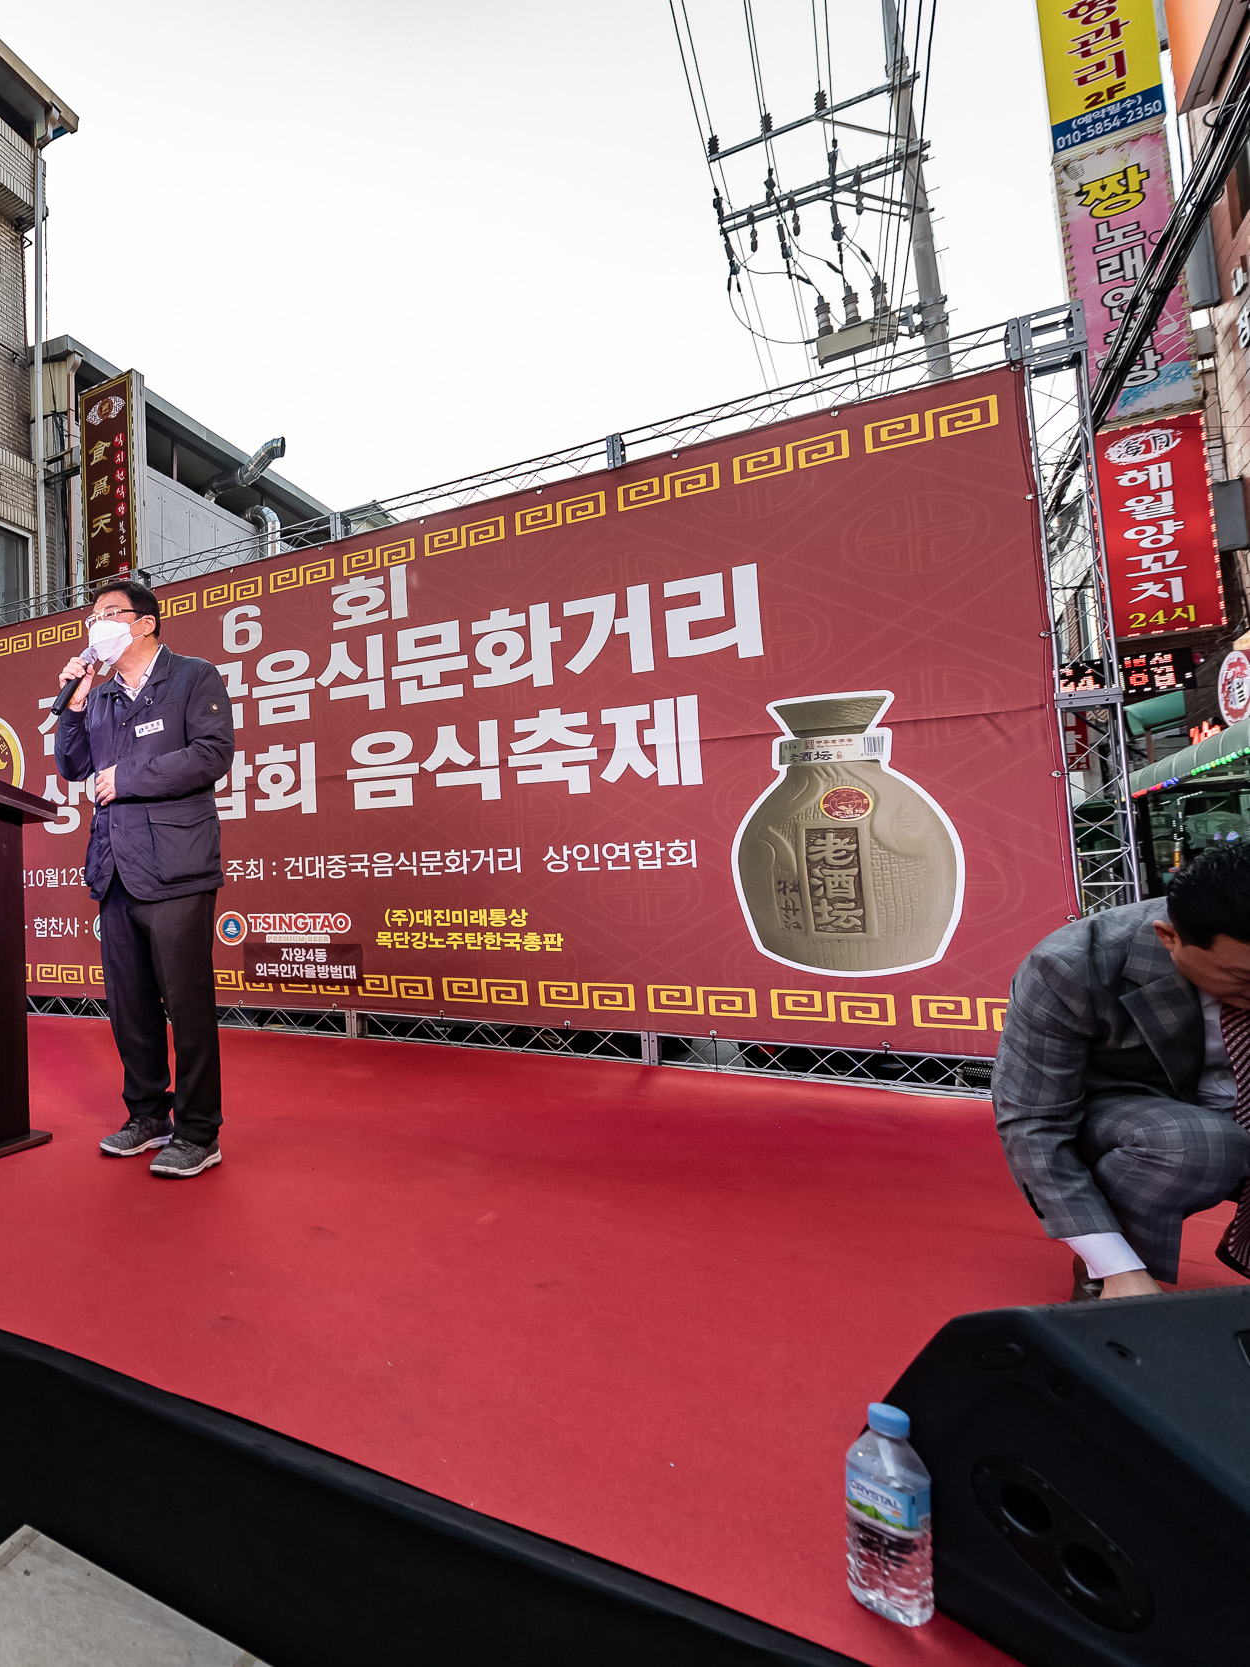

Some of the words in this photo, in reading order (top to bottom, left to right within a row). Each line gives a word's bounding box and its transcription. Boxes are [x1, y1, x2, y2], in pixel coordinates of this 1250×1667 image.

[1071, 94, 1143, 129] (예약필수)
[1084, 81, 1127, 110] 2F
[1055, 99, 1163, 149] 010-5854-2350
[117, 520, 128, 556] 불고기
[1115, 461, 1190, 605] 해월양꼬치
[222, 605, 263, 655] 6
[330, 564, 409, 632] 회
[1129, 604, 1197, 630] 24시
[347, 694, 704, 811] 음식축제
[226, 858, 265, 882] 주최
[284, 846, 523, 881] 건대중국음식문화거리
[542, 838, 699, 874] 상인연합회
[807, 831, 864, 930] 老酒坛
[33, 916, 80, 938] 협찬사
[248, 912, 352, 934] TSINGTAO
[384, 907, 529, 928] (주)대진미래통상
[281, 947, 328, 963] 자양4동
[375, 930, 564, 953] 목단강노주탄한국총판
[255, 962, 357, 980] 외국인자율방범대
